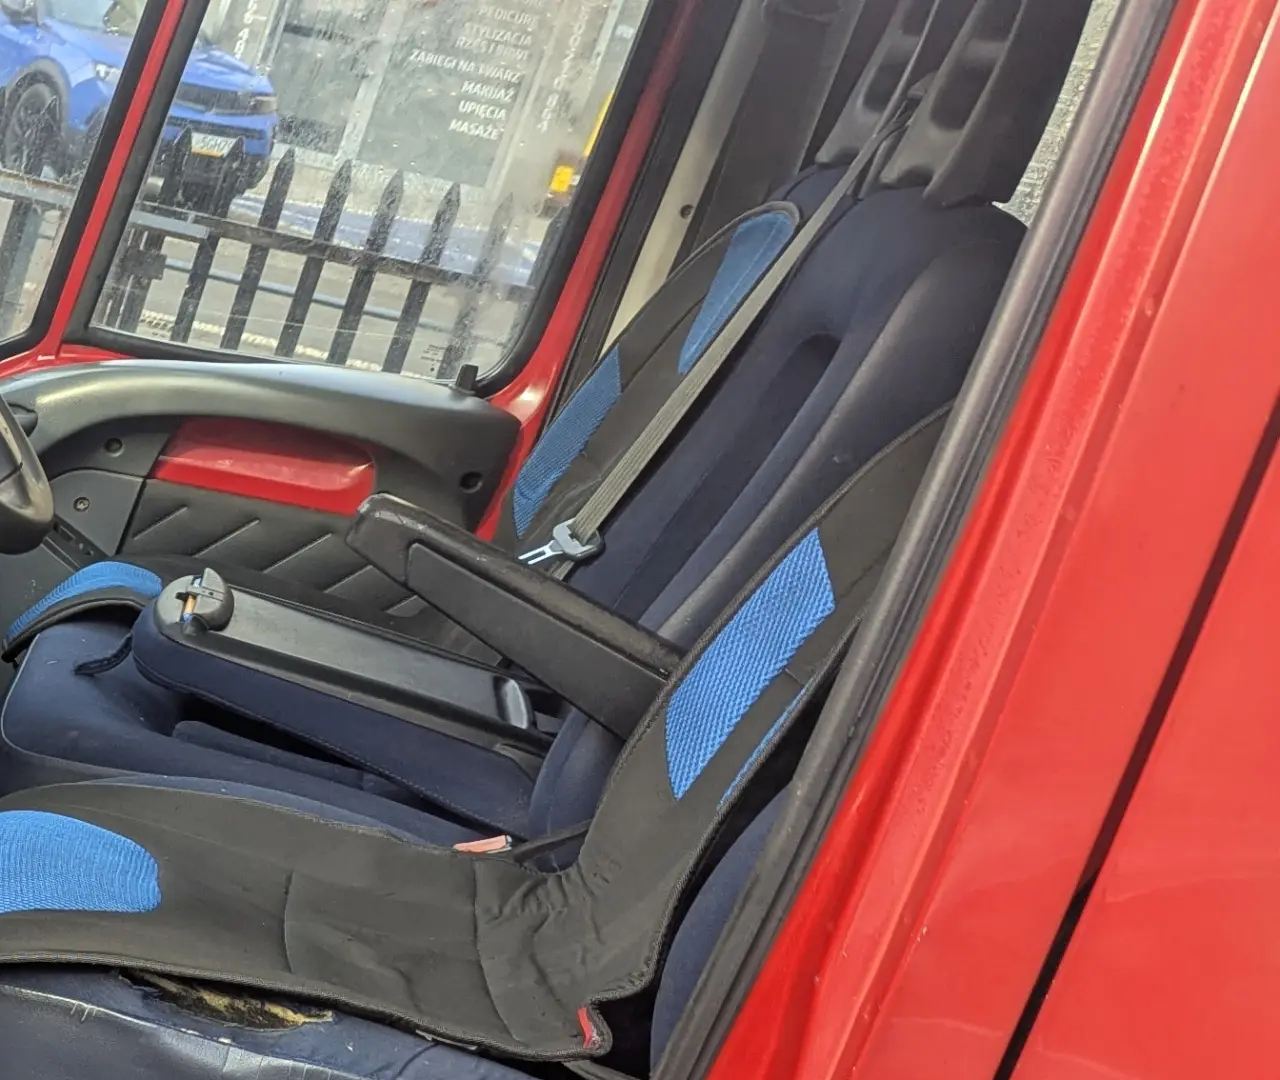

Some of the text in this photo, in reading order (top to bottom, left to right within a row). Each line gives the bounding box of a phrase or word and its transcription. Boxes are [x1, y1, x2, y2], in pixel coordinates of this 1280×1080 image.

[409, 49, 460, 69] ZABIEGI
[458, 59, 476, 74] NA
[458, 99, 507, 120] UPIĘCIA
[448, 119, 500, 140] MASAŻE
